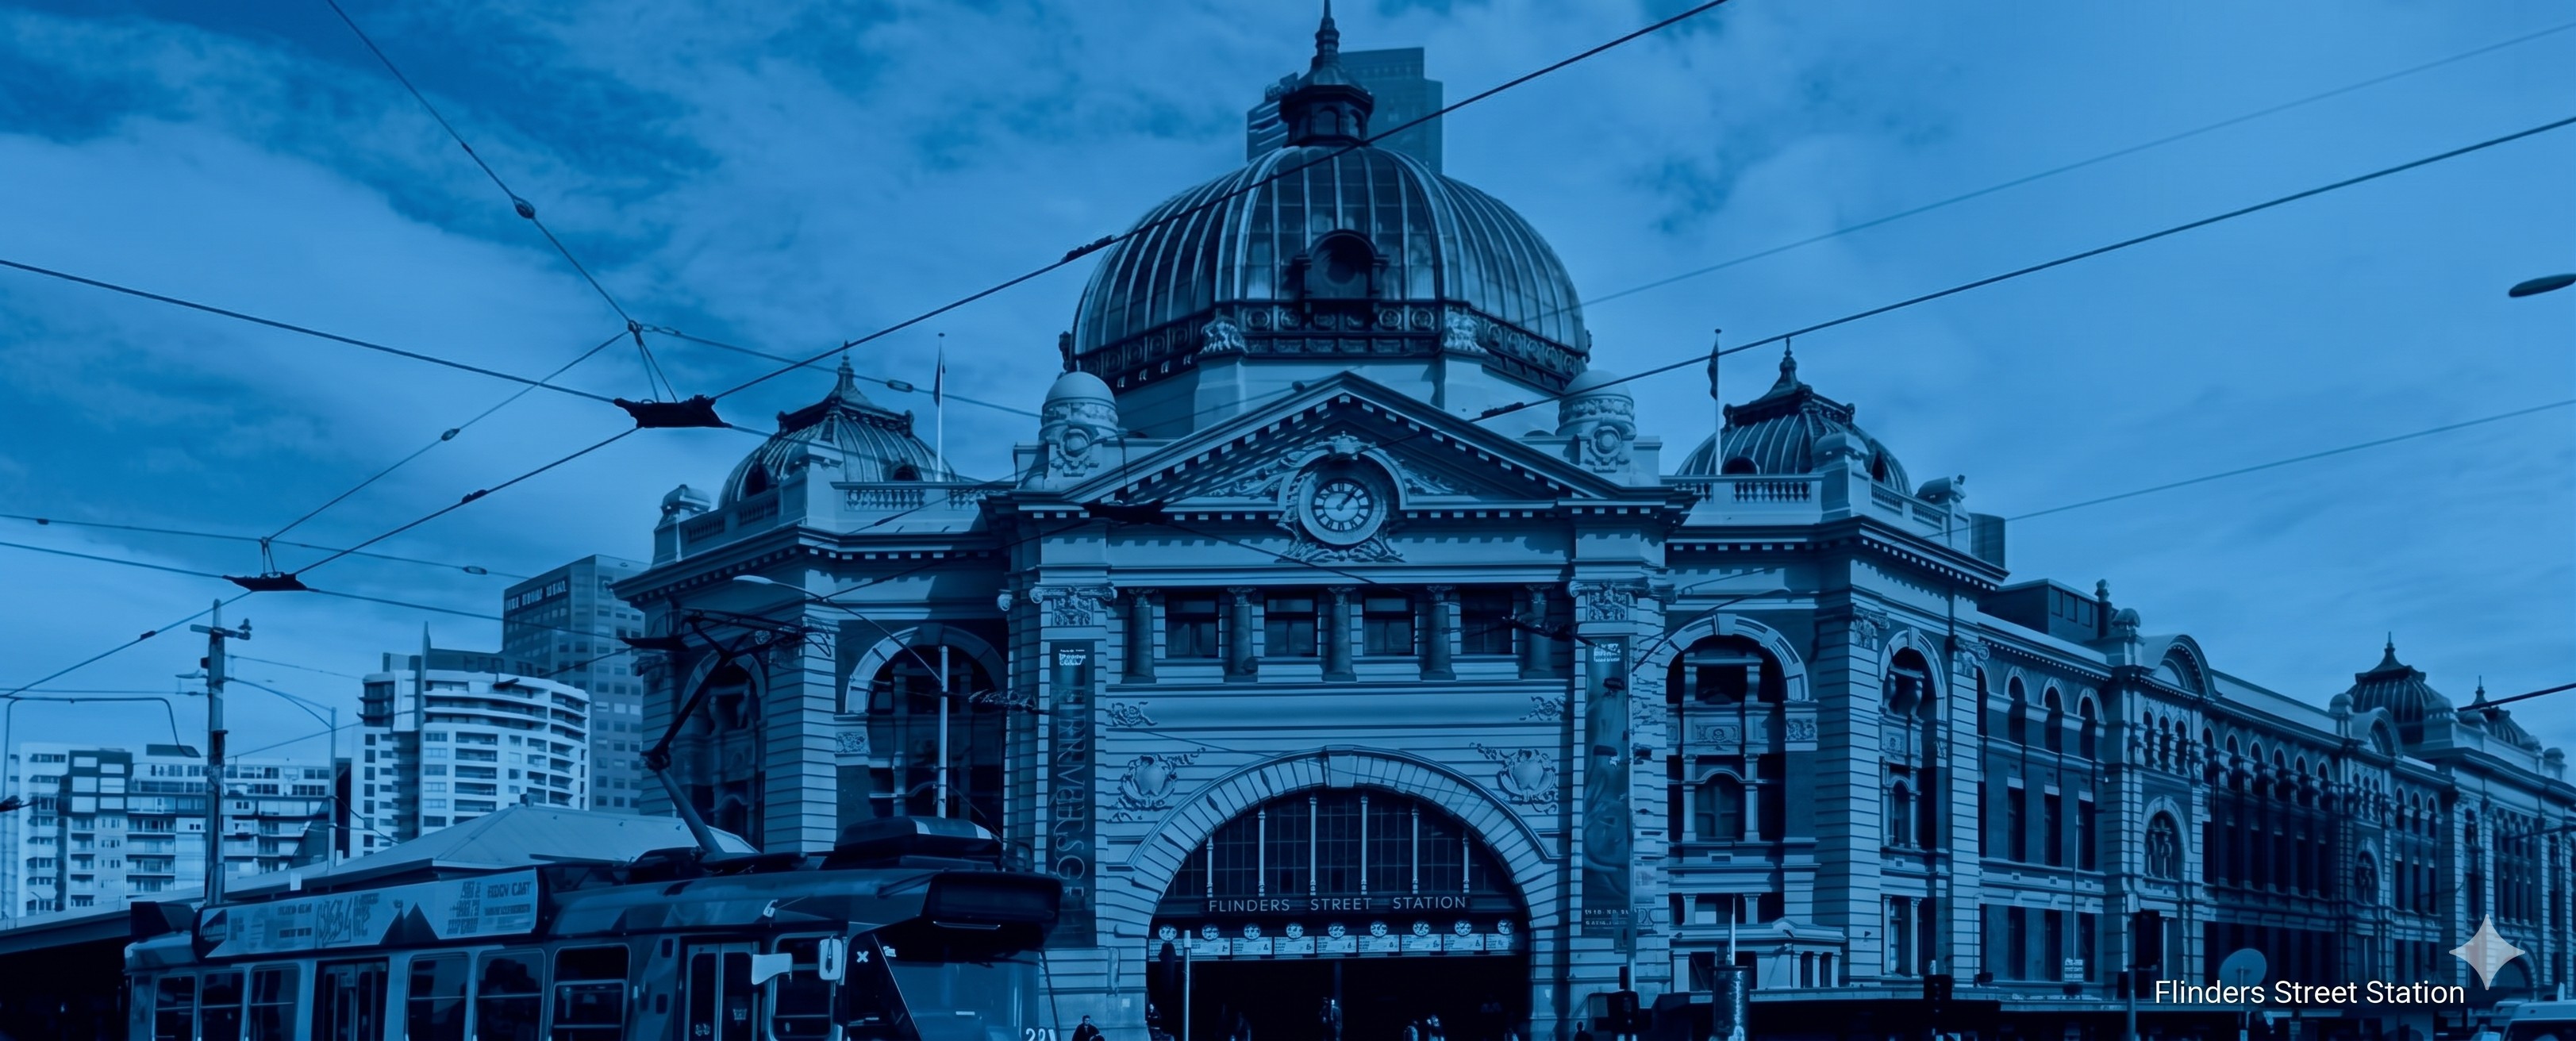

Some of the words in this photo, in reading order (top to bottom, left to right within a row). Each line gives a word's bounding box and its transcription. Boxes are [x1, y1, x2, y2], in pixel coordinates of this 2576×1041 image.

[1209, 899, 1290, 912] FLINDERS
[1310, 897, 1372, 911] STREET
[1393, 896, 1466, 909] STATION
